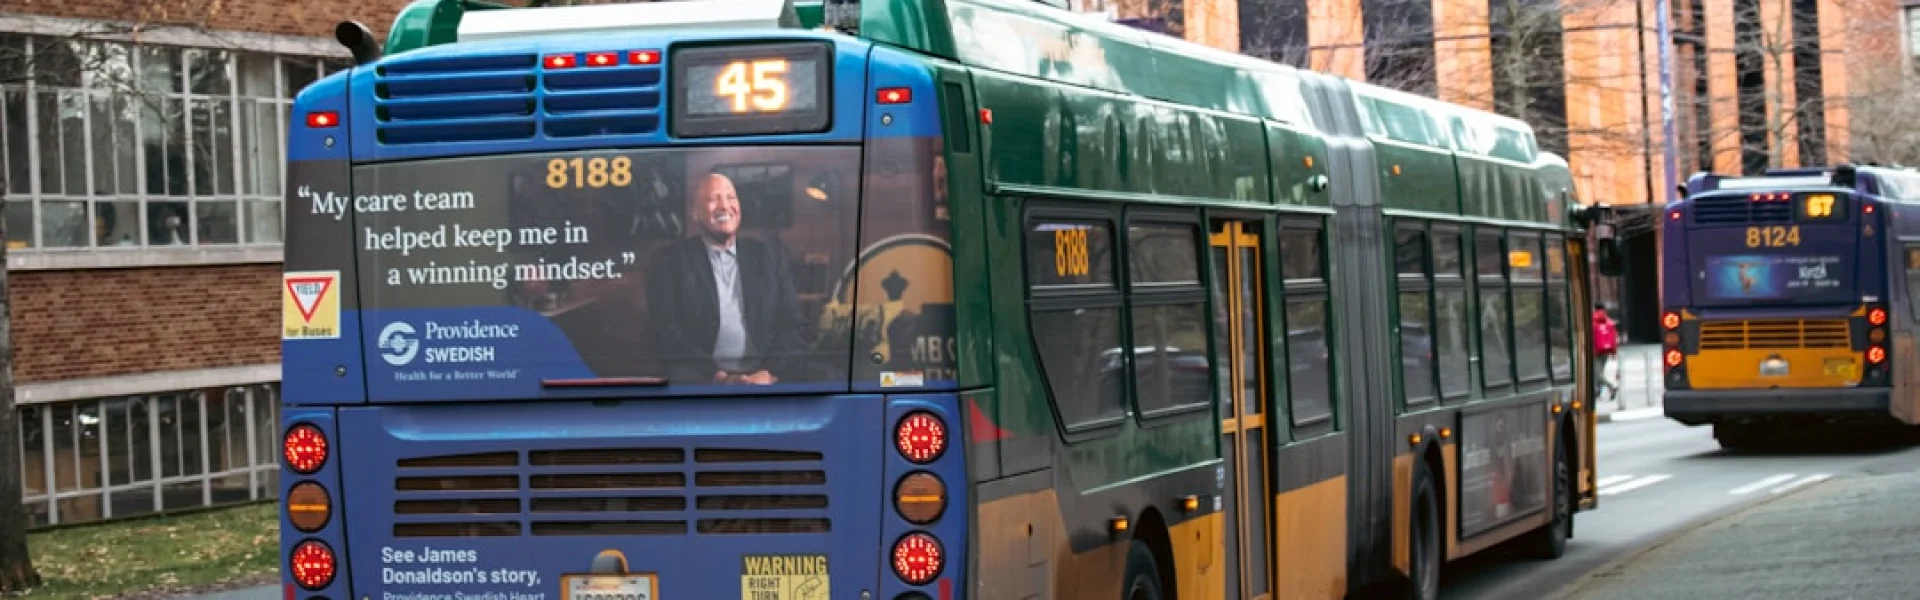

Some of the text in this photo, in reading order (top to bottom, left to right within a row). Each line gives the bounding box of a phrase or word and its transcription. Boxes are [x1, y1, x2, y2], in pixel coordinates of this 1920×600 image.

[714, 58, 790, 114] 45
[546, 155, 632, 189] 8188
[297, 185, 475, 220] “My care team
[364, 220, 589, 256] helped keep me in
[1746, 225, 1800, 248] 8124
[1055, 227, 1089, 277] 8188
[387, 251, 635, 289] a winning mindset.”
[295, 283, 320, 295] YIELD
[302, 325, 332, 337] Buses
[425, 319, 519, 340] Providence
[425, 346, 495, 363] SWEDISH
[395, 370, 427, 381] Health
[430, 370, 443, 379] for
[445, 372, 452, 380] a
[454, 370, 484, 379] Better
[382, 546, 477, 563] See James
[744, 556, 827, 574] WARNING
[383, 567, 541, 587] Donaldson's story,
[749, 577, 780, 589] RIGHT
[383, 591, 545, 600] Providence Swedish Heart
[751, 591, 780, 600] TURN
